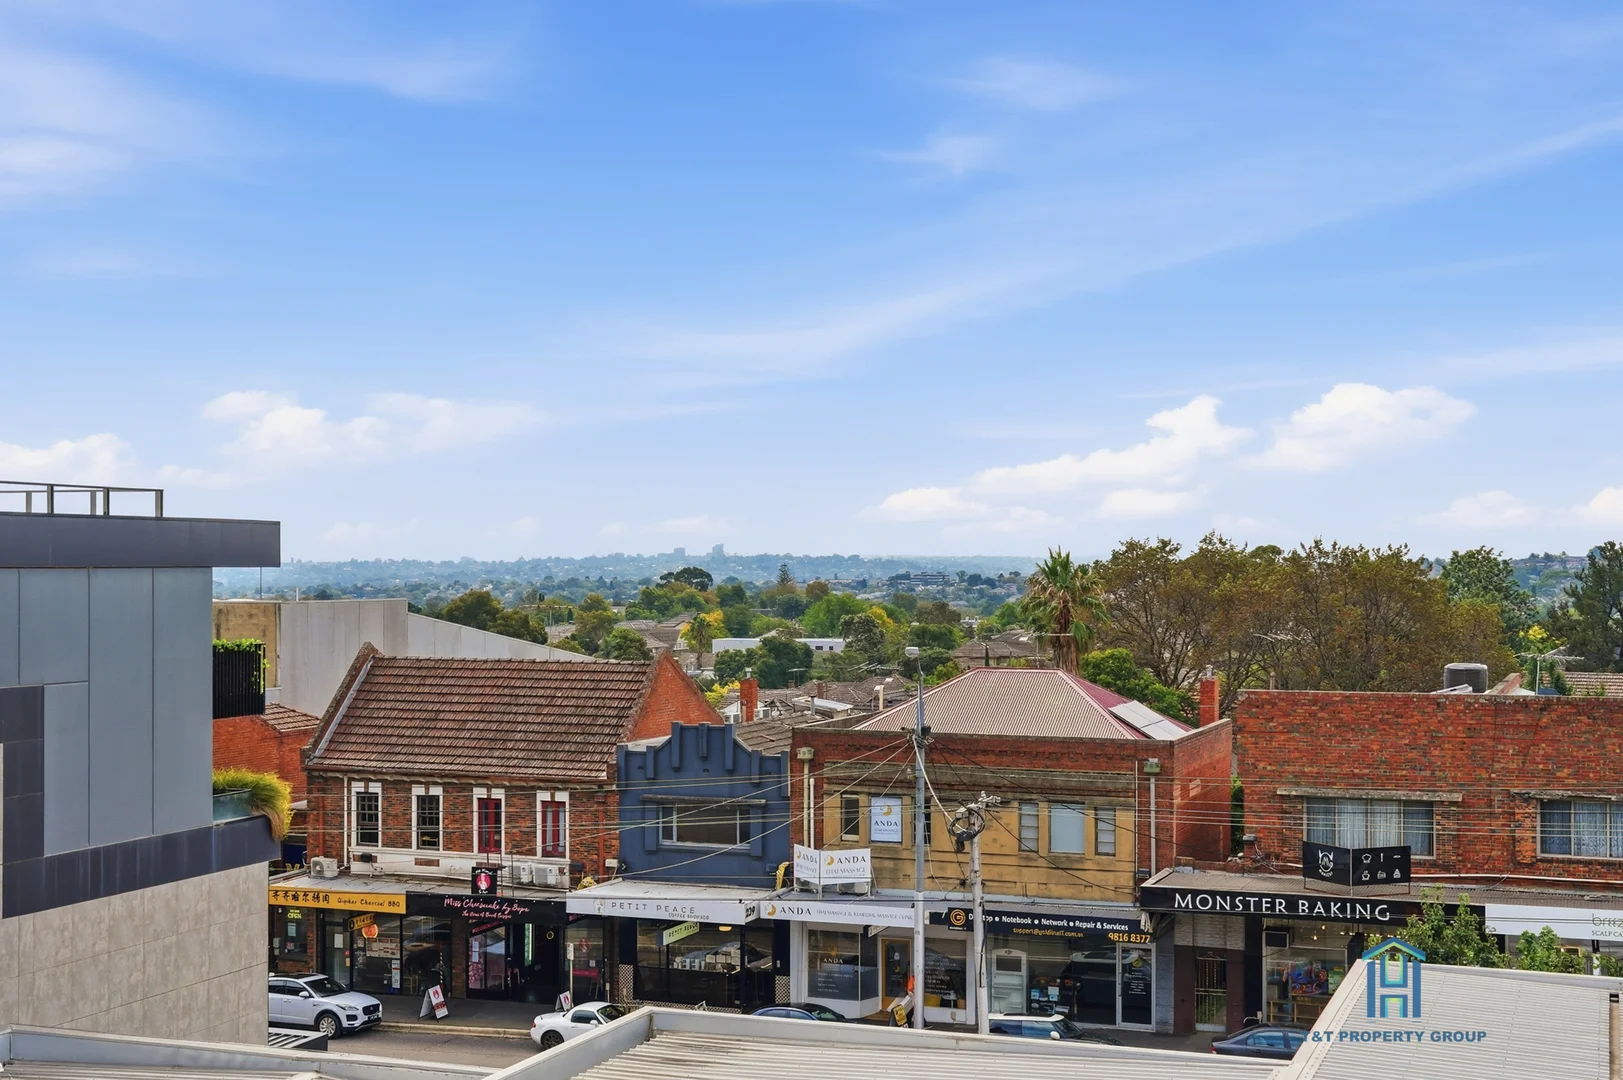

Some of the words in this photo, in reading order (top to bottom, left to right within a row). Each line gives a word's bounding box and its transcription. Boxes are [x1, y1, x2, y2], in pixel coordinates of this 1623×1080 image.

[802, 853, 818, 865] ANDA
[836, 855, 866, 865] ANDA
[360, 898, 385, 907] Charcoal
[387, 900, 401, 908] BBQ
[443, 897, 461, 908] Miss
[462, 898, 500, 910] Cheesecake
[501, 902, 512, 914] by
[611, 902, 648, 911] PETIT
[656, 905, 695, 914] PEACE
[1174, 893, 1288, 914] MONSTER
[1298, 899, 1390, 921] BAKING
[780, 906, 812, 916] ANDA
[968, 914, 993, 923] Dtop
[1001, 915, 1032, 925] Notebook
[1041, 918, 1068, 927] Network
[1075, 920, 1095, 930] Repair
[1102, 922, 1129, 931] Services
[668, 927, 683, 938] PETIT
[1107, 932, 1129, 942] 9816
[1130, 933, 1151, 944] 8377
